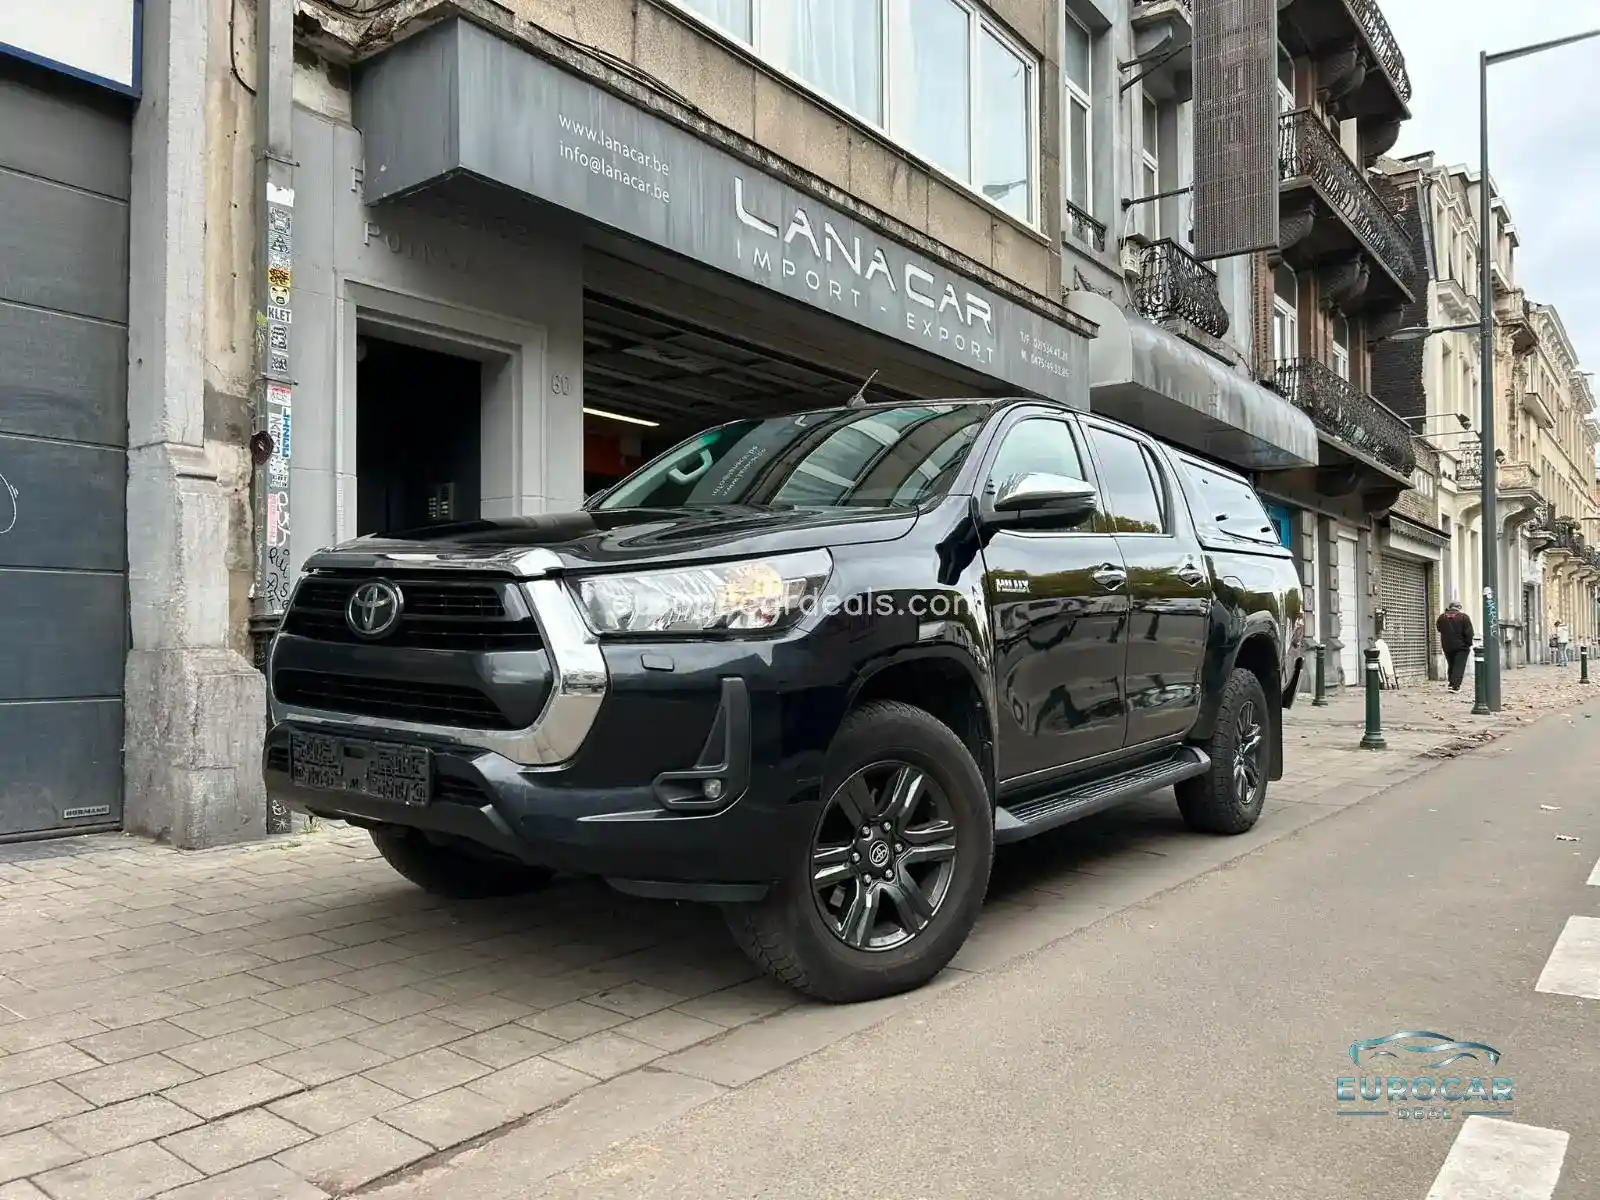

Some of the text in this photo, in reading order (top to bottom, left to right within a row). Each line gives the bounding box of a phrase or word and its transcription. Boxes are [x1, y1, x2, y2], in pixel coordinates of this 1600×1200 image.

[559, 114, 669, 176] www.lanacar.be
[560, 140, 670, 203] info@lanacar.be
[737, 237, 861, 307] IMPORT
[906, 311, 994, 364] EXPORT
